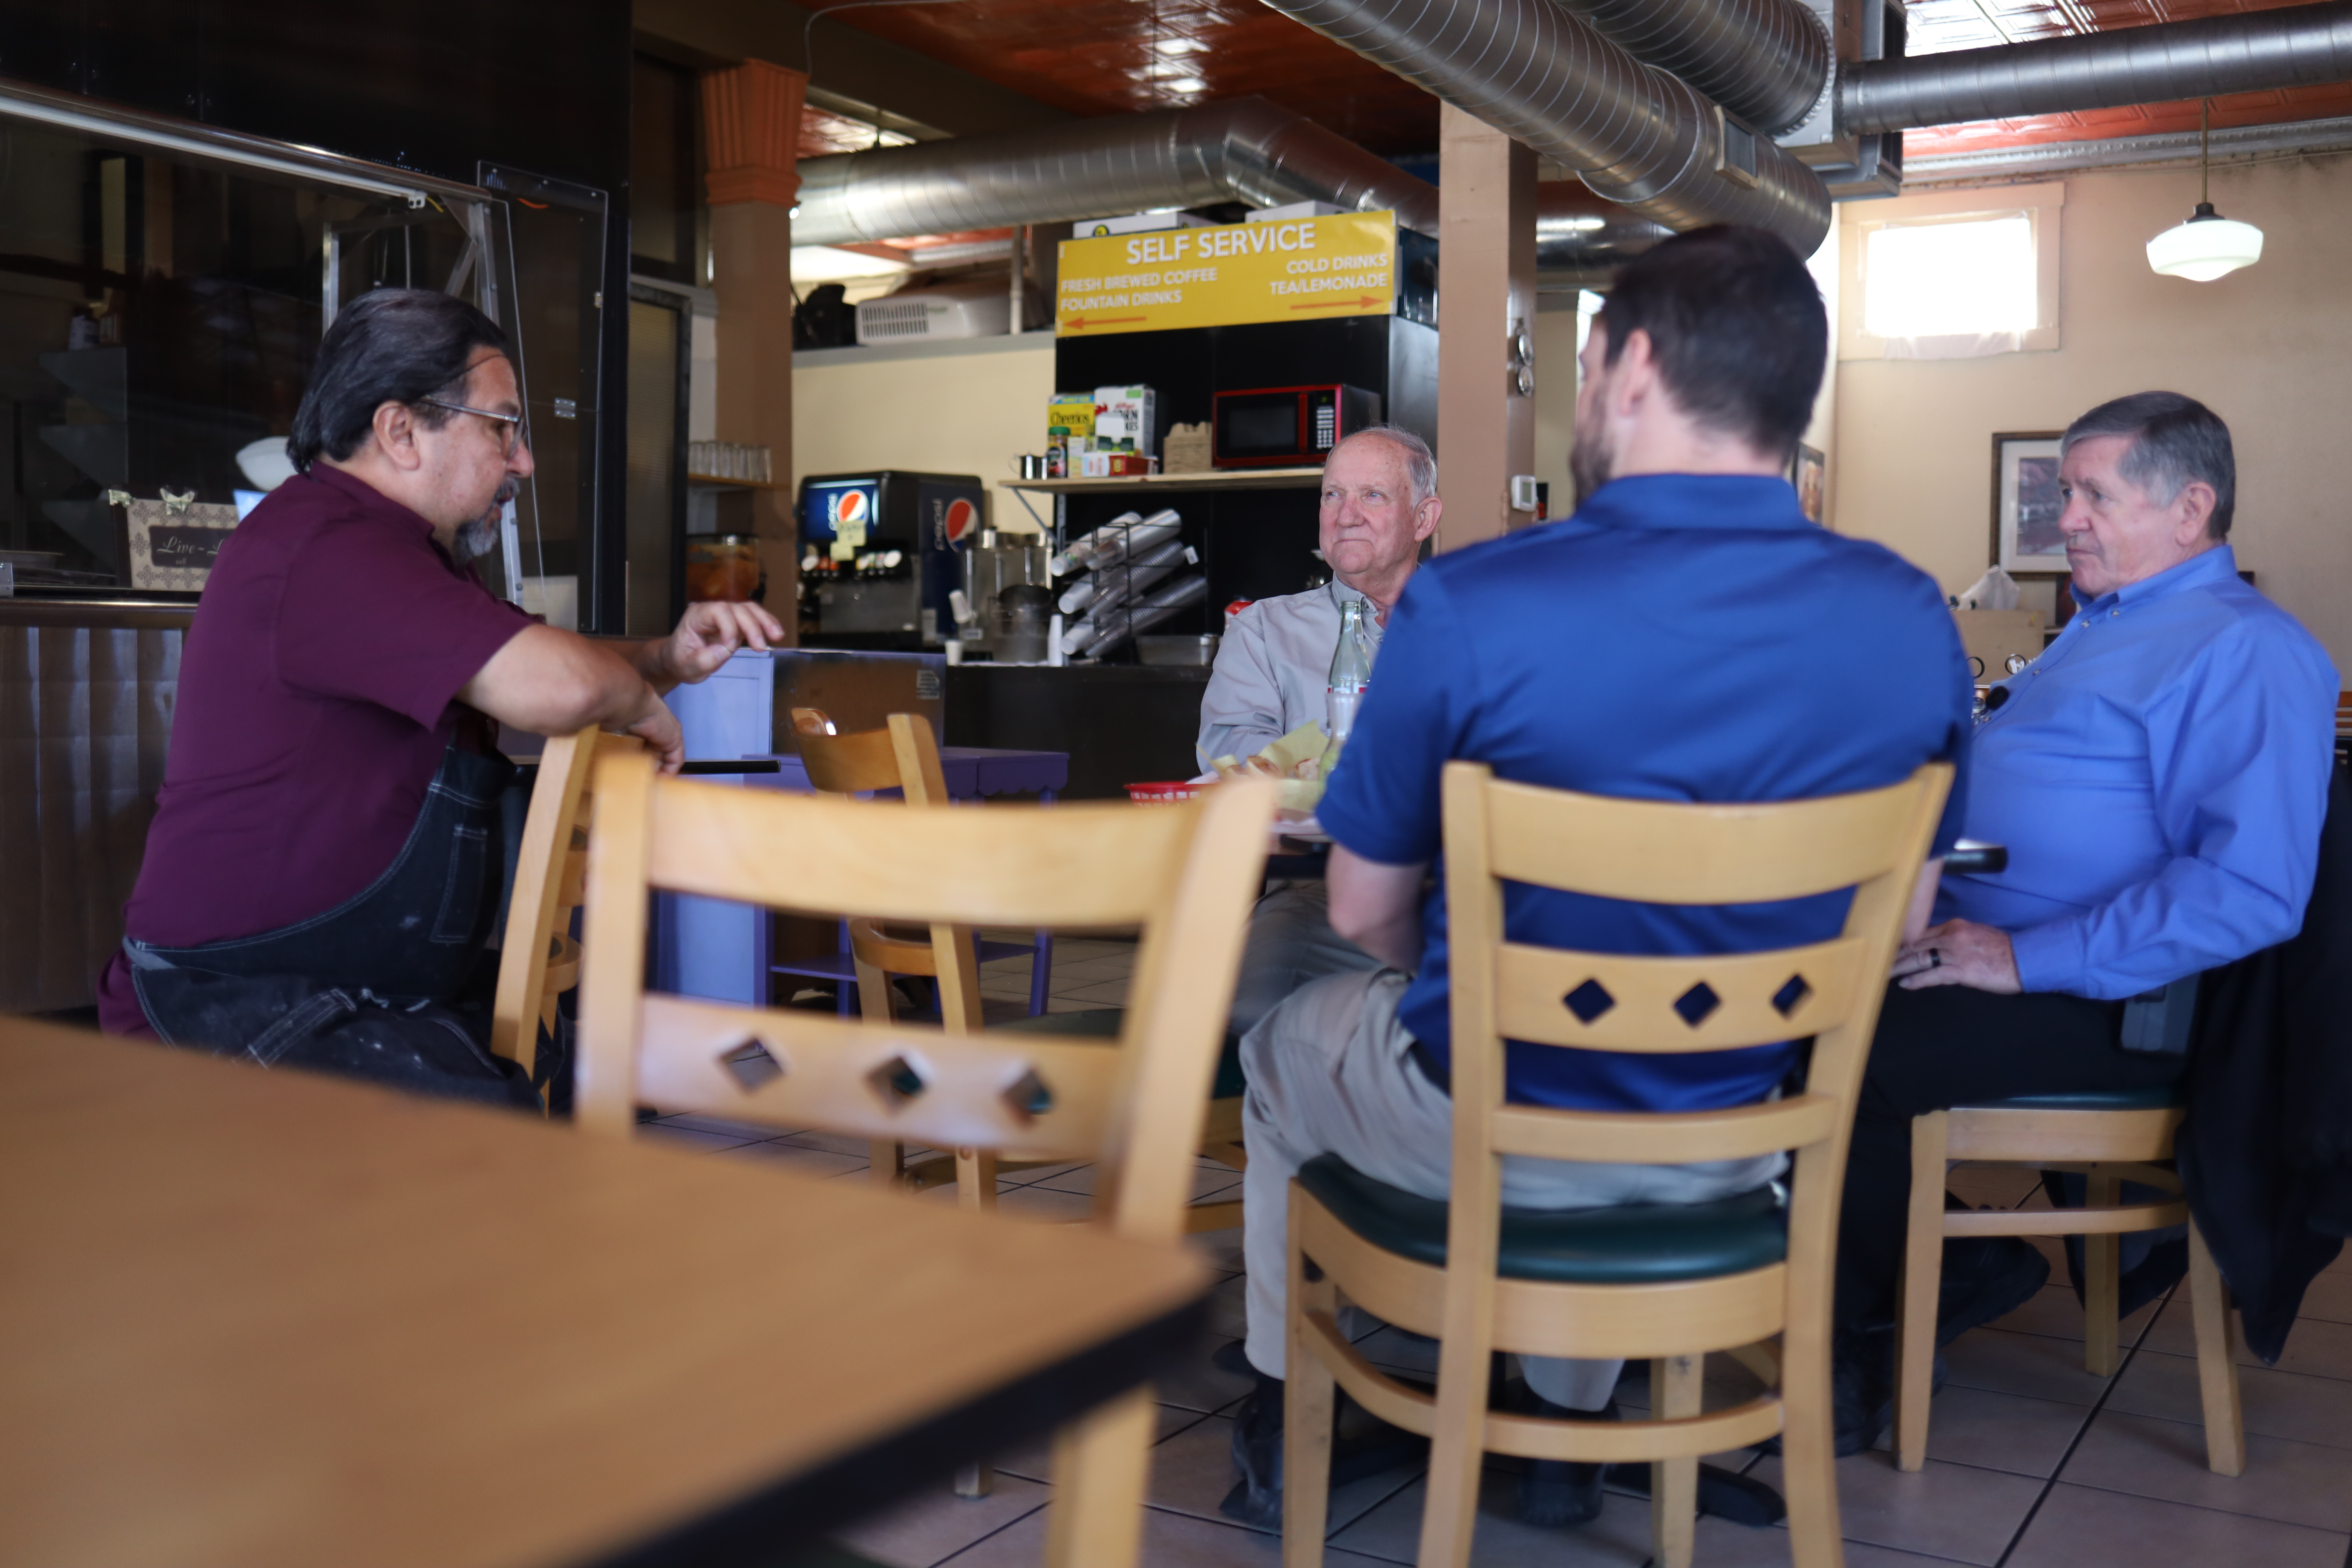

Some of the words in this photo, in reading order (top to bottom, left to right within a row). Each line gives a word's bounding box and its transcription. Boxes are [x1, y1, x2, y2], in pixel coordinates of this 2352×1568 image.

[1126, 234, 1190, 264] SELF
[1197, 222, 1316, 259] SERVICE
[1286, 258, 1328, 274] COLD
[1332, 253, 1388, 271] DRINKS
[1061, 278, 1102, 293] FRESH
[1104, 273, 1161, 289] BREWED
[1163, 267, 1218, 285] COFFEE
[1269, 273, 1389, 295] TEA/LEMONADE
[1060, 294, 1129, 311] FOUNTAIN
[1132, 289, 1182, 306] DRINKS
[1050, 412, 1089, 426] Cheerios
[828, 493, 838, 531] pepsi
[932, 499, 945, 551] pepsi
[156, 536, 195, 554] Live
